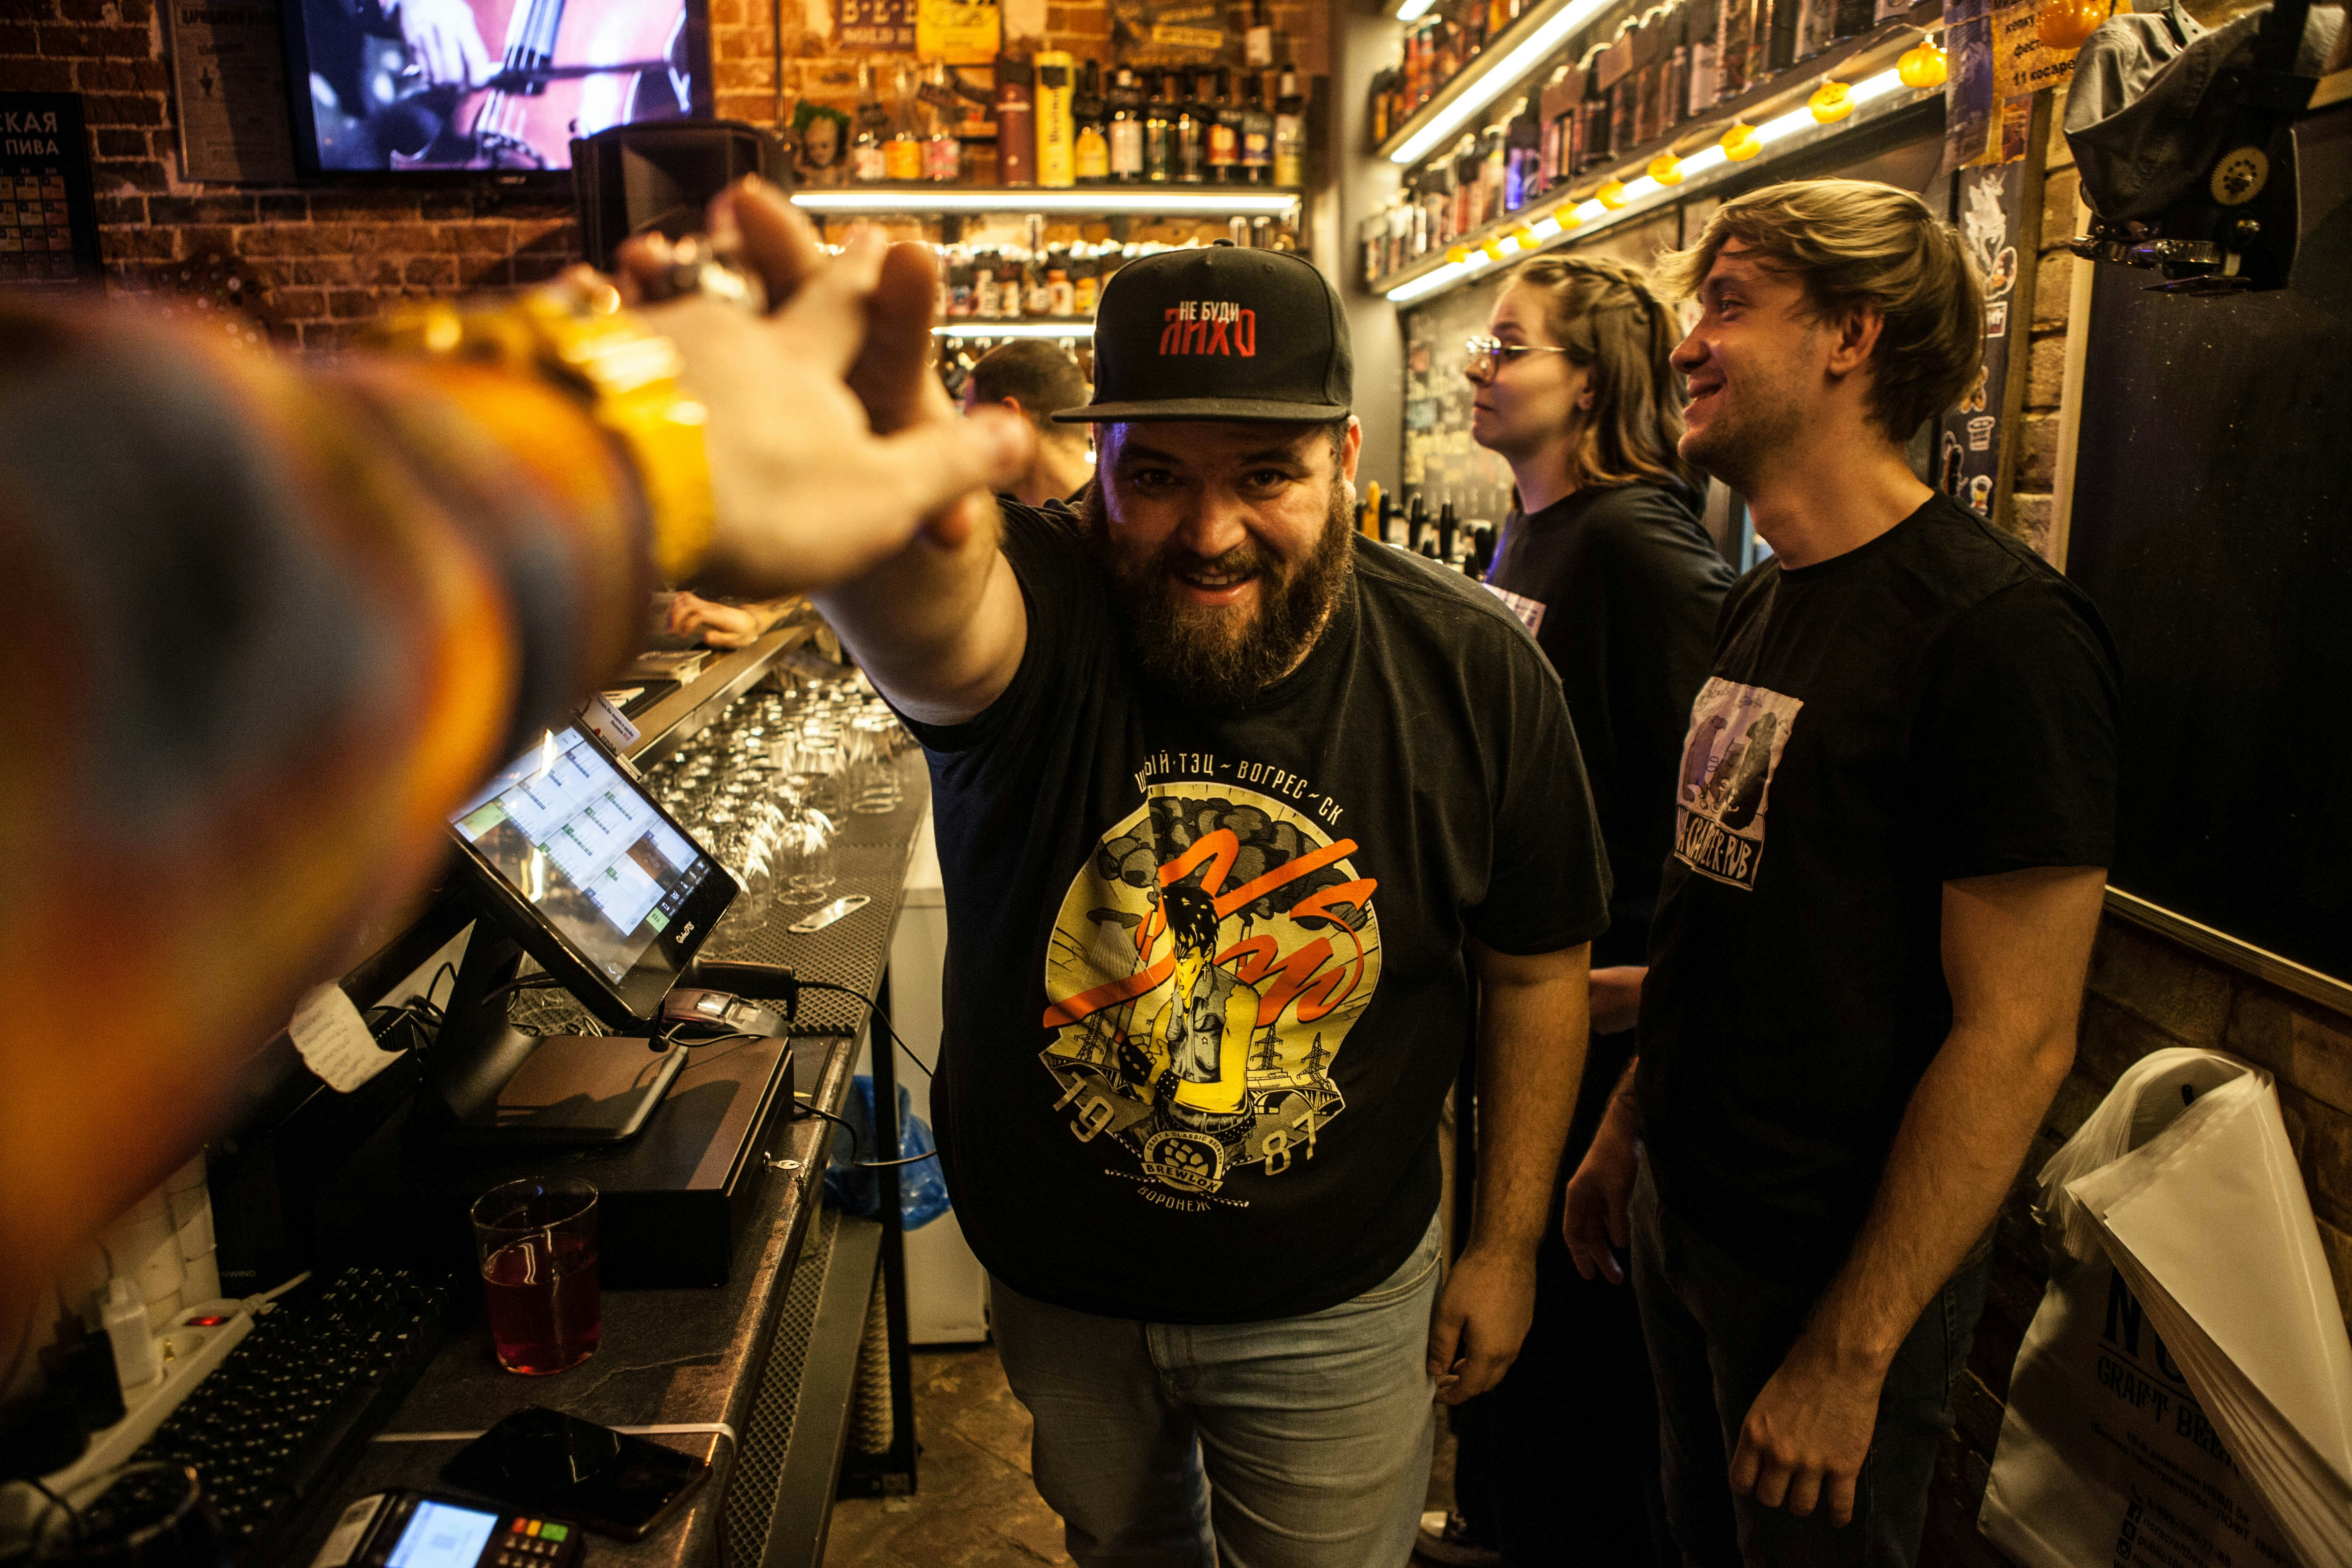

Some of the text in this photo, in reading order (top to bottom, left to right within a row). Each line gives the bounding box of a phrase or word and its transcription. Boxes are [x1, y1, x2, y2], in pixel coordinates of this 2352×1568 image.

[2014, 59, 2076, 86] 11 косаре
[4, 138, 61, 156] ПИВА
[1179, 300, 1240, 324] НЕ БУДИ
[1179, 753, 1214, 776] ТЭЦ
[1237, 761, 1308, 799] ВОГРЕС
[1318, 797, 1344, 825] СК
[1723, 836, 1751, 879] PUB
[676, 921, 694, 944] GlobalPOS
[1053, 1071, 1115, 1142] 19
[1147, 1133, 1162, 1150] CRAFT
[1172, 1132, 1207, 1141] CLASSIC
[1209, 1139, 1223, 1165] BREWERY
[1262, 1109, 1317, 1176] 87
[1146, 1164, 1217, 1191] BREWLOK
[1137, 1186, 1211, 1212] ВОРОНЕЖ
